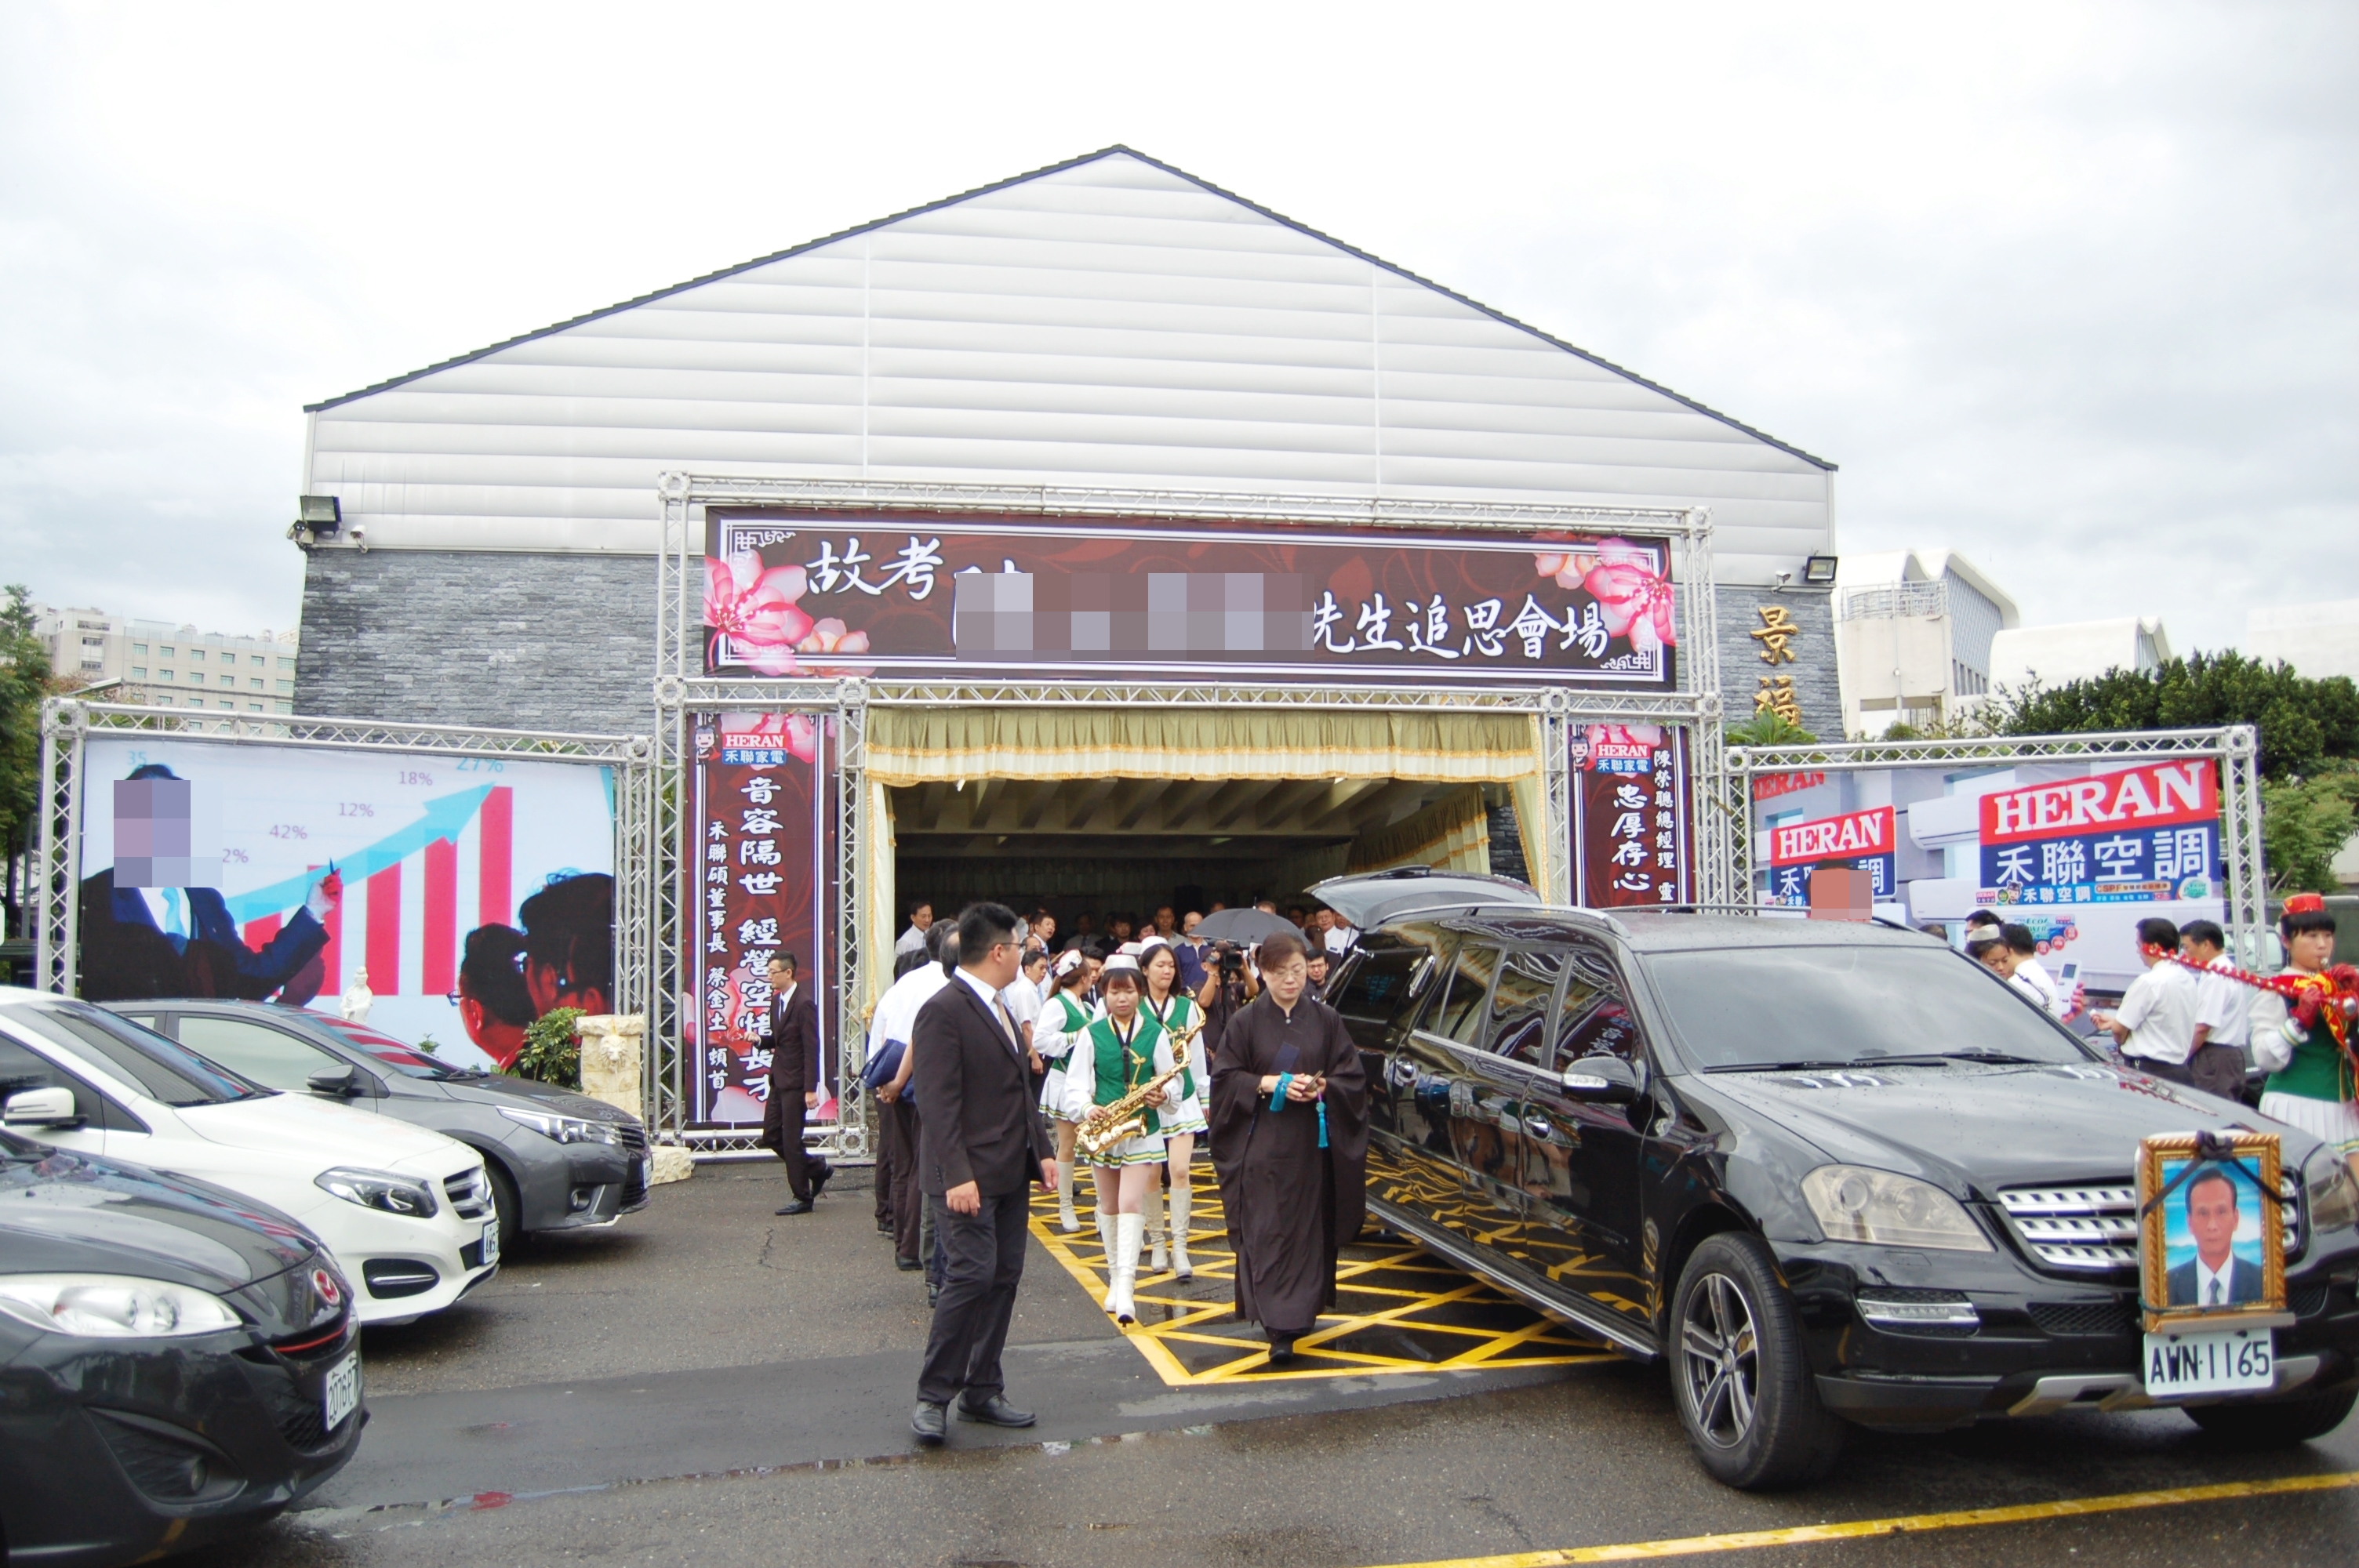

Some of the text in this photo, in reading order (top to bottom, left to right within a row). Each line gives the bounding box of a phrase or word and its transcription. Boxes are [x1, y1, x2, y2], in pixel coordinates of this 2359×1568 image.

[805, 536, 943, 601] 故考
[1314, 590, 1610, 659] 先生追思會場
[725, 734, 784, 748] HERAN
[725, 750, 785, 764] 禾聯家電
[1598, 745, 1648, 757] HERAN
[1598, 759, 1648, 772] 禾聯家電
[398, 771, 434, 786] 18%
[1994, 760, 2205, 835] HERAN
[339, 803, 374, 817] 12%
[269, 826, 308, 840] 42%
[739, 776, 783, 895] 音容隔世
[1610, 784, 1650, 891] 忠厚存心
[1779, 812, 1883, 859] HERAN
[1995, 826, 2210, 885] 禾聯空調
